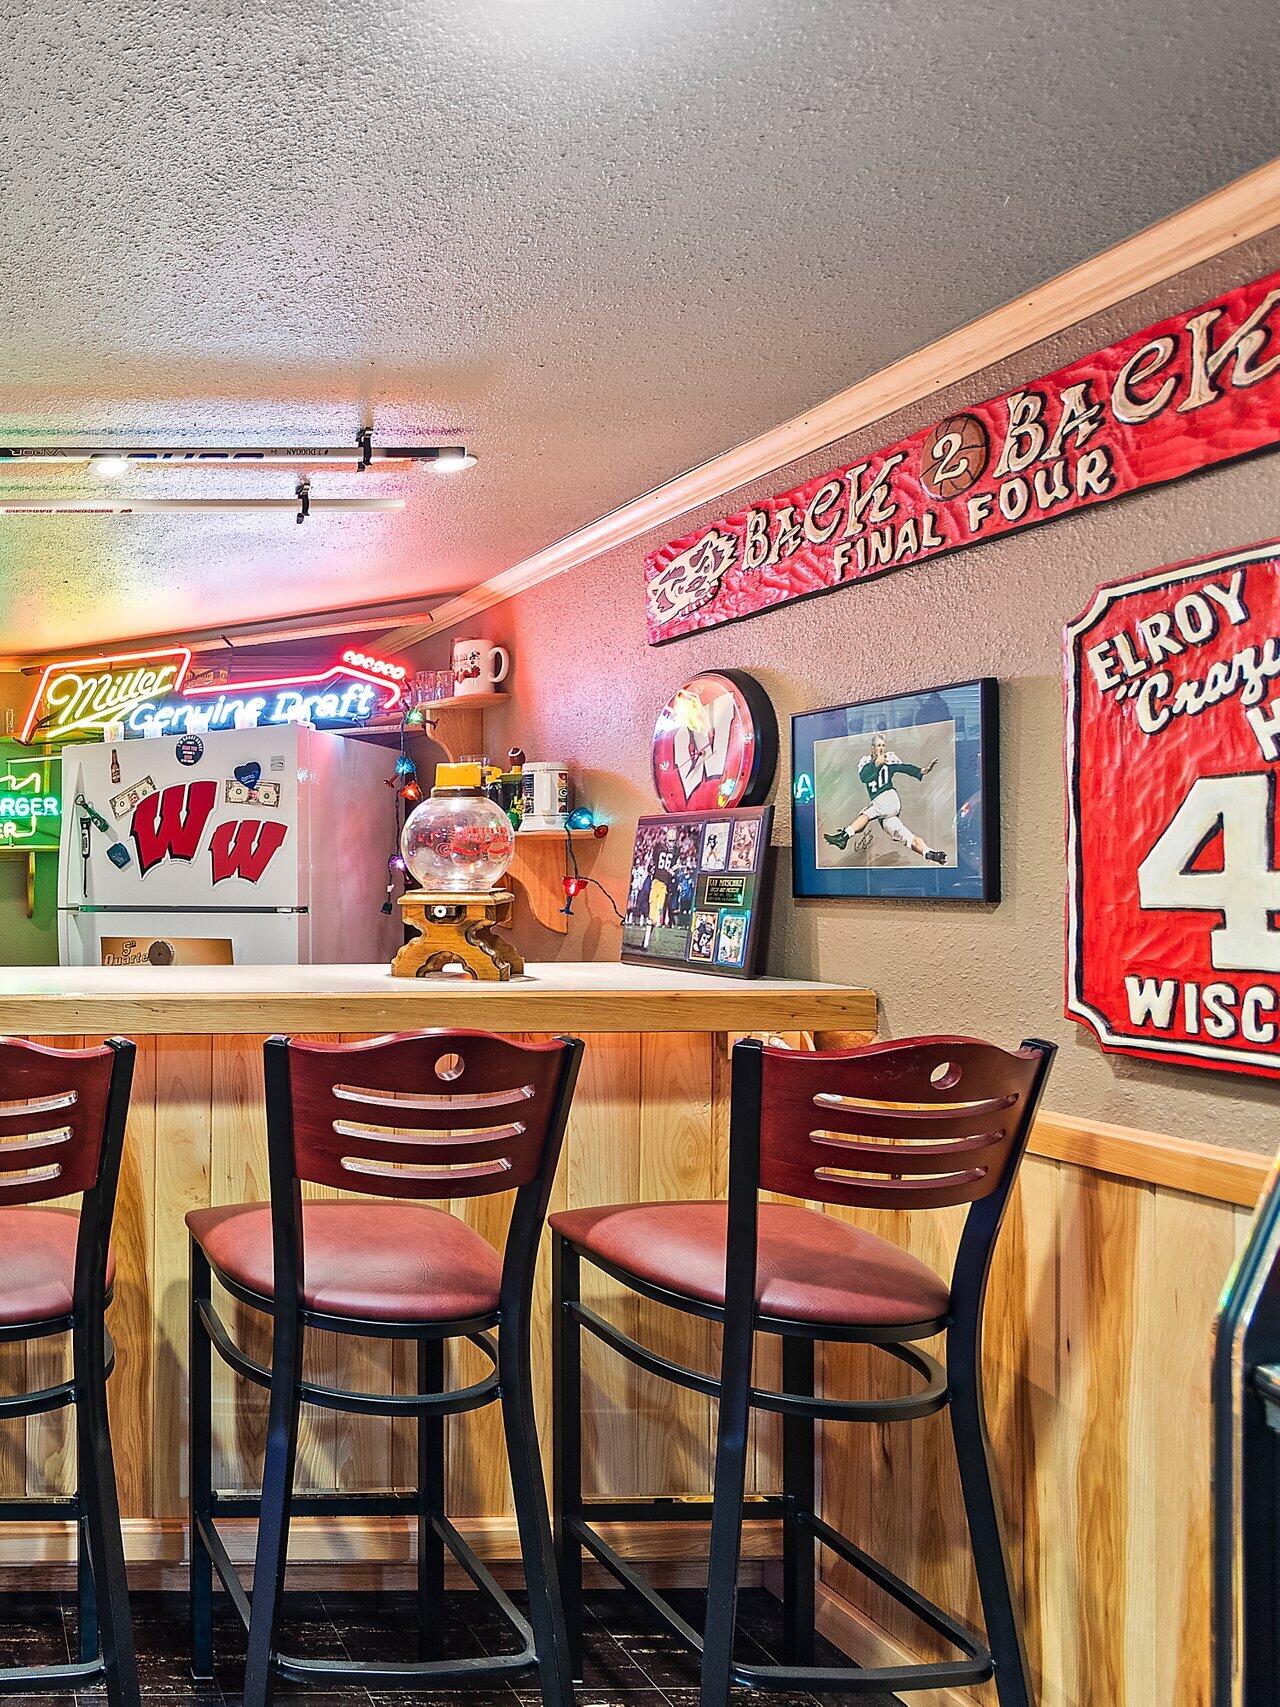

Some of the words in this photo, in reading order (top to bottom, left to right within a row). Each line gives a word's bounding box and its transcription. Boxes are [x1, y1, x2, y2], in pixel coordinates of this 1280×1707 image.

[9, 448, 68, 457] VAPOR
[931, 433, 969, 485] 2
[833, 512, 943, 582] FINAL
[968, 450, 1112, 534] FOUR
[1087, 570, 1248, 693] ELROY
[47, 666, 178, 724] Miller
[129, 695, 267, 731] Genuine
[271, 683, 376, 722] Draft
[129, 781, 218, 878] W
[208, 819, 288, 886] W
[658, 852, 674, 870] 66
[1137, 773, 1280, 971] 4
[104, 953, 149, 966] Quarte
[1124, 975, 1278, 1043] WISC
